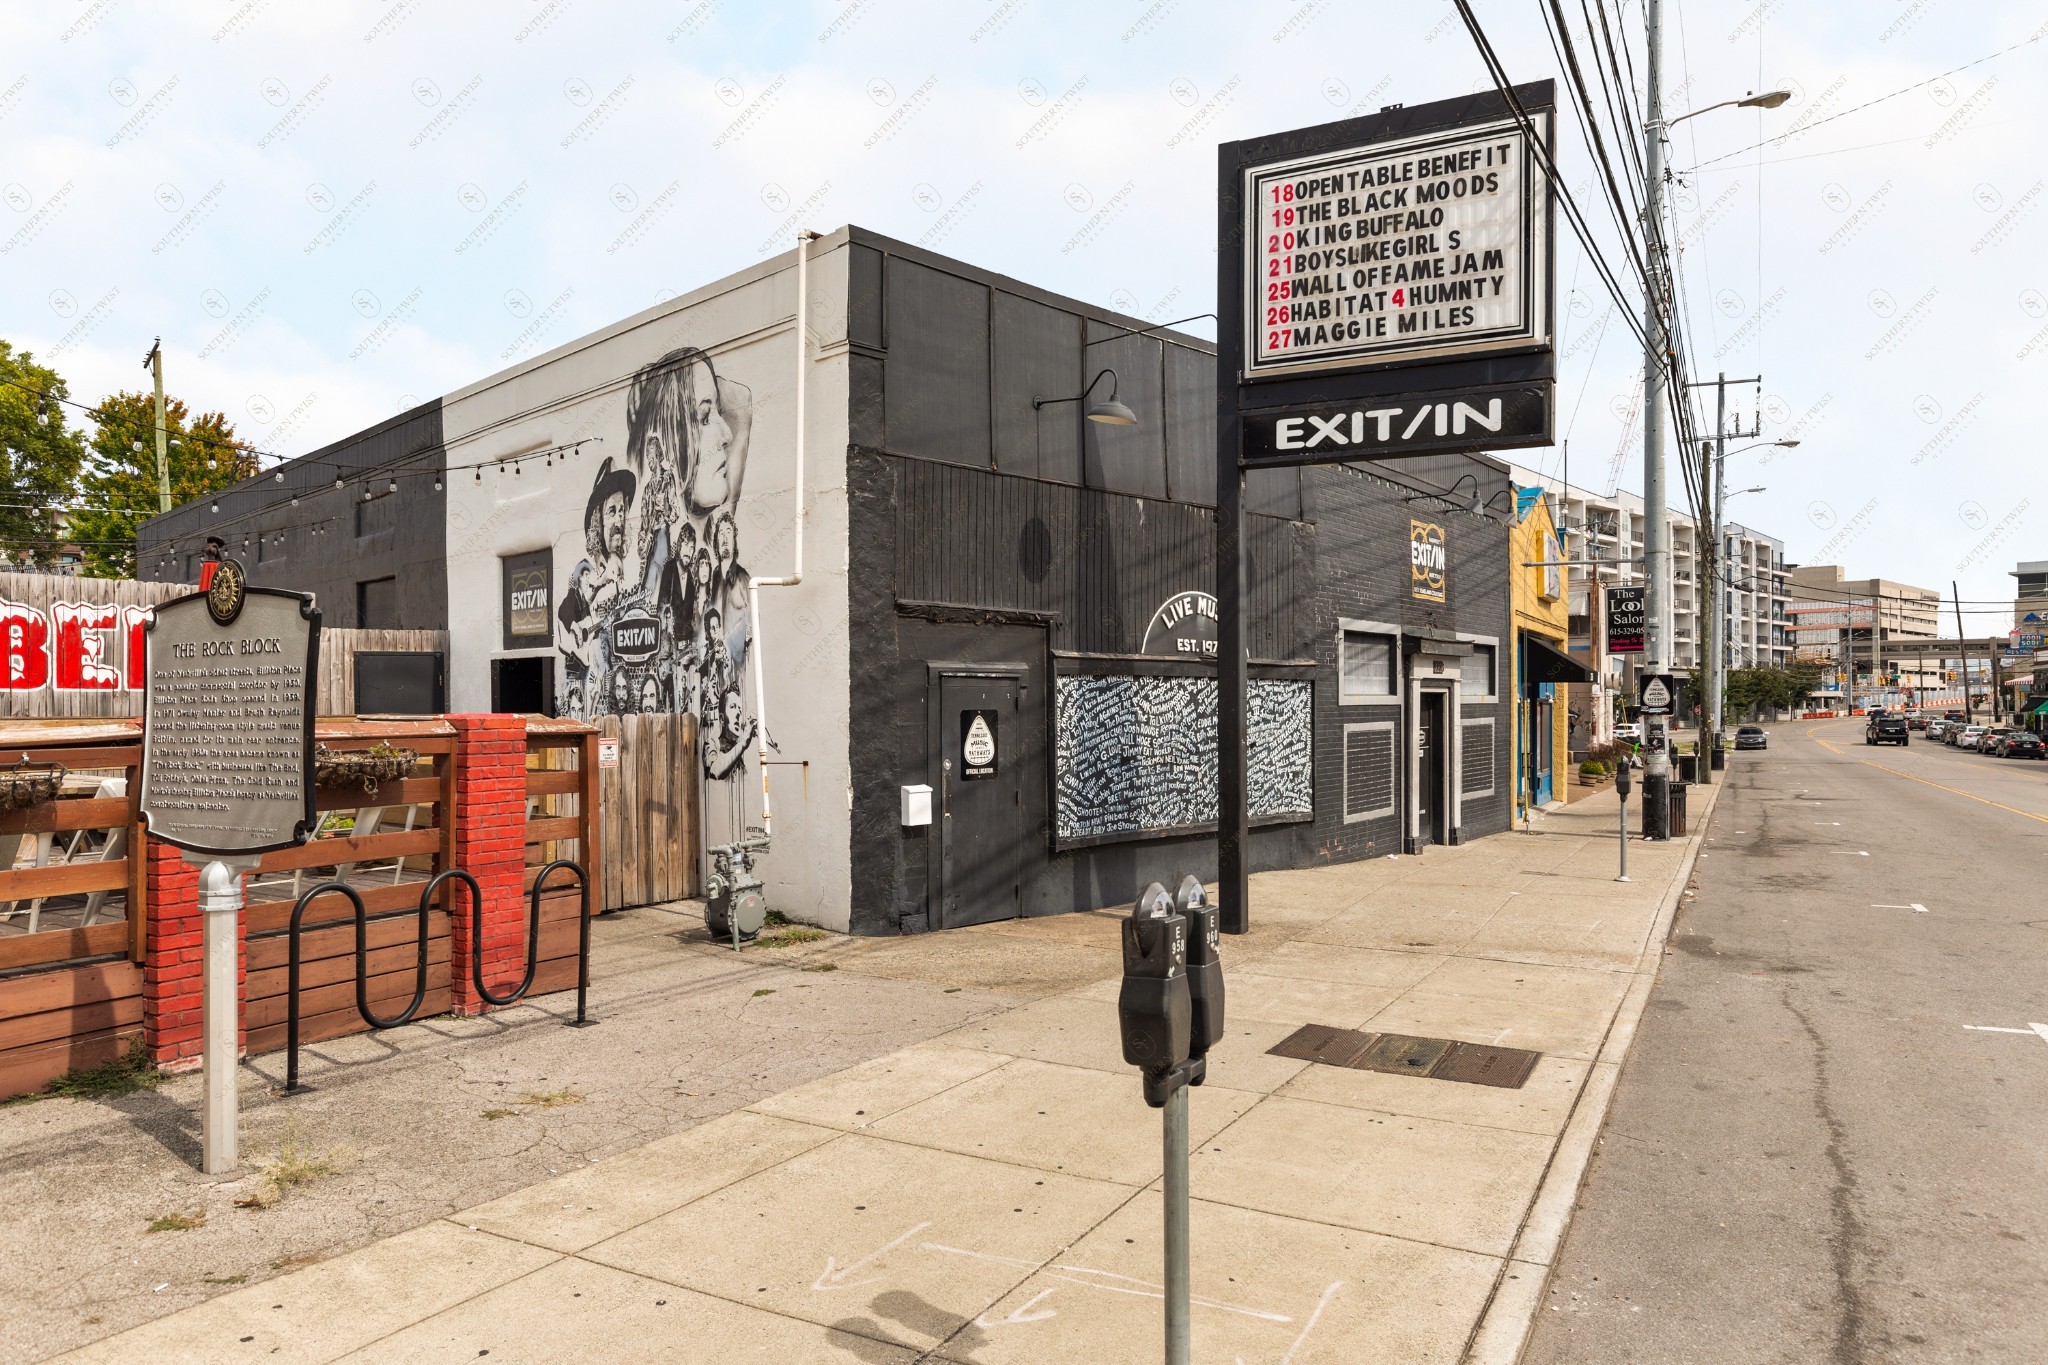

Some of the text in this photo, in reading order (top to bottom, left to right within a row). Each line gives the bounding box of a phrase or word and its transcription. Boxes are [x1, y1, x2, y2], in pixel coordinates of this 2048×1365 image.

[1271, 143, 1511, 204] 18 OPEN TABLE BENEFIT
[1272, 172, 1499, 228] 19 THE BLACK MOODS
[1269, 207, 1444, 253] 20 KING BUFFALO
[1268, 249, 1504, 302] 25 WALL OF FAME JAM
[1267, 274, 1505, 326] 26 HABITAT 4 HUMNTY
[1269, 305, 1474, 350] 27 MAGGIE MILES
[1275, 398, 1502, 450] EXIT/IN
[1411, 540, 1445, 571] EXIT/IN
[511, 588, 548, 611] EXIT/IN
[1615, 589, 1635, 599] The
[1161, 596, 1193, 629] LIVE
[173, 637, 282, 658] THE ROCK BLOCK
[617, 626, 655, 647] EXIT/IN
[1177, 638, 1199, 653] EST.
[970, 739, 989, 748] MUSIC
[1064, 774, 1084, 792] GWAR
[1175, 925, 1181, 940] E
[1210, 915, 1215, 928] E
[1171, 939, 1185, 955] 958
[1206, 929, 1218, 945] 960
